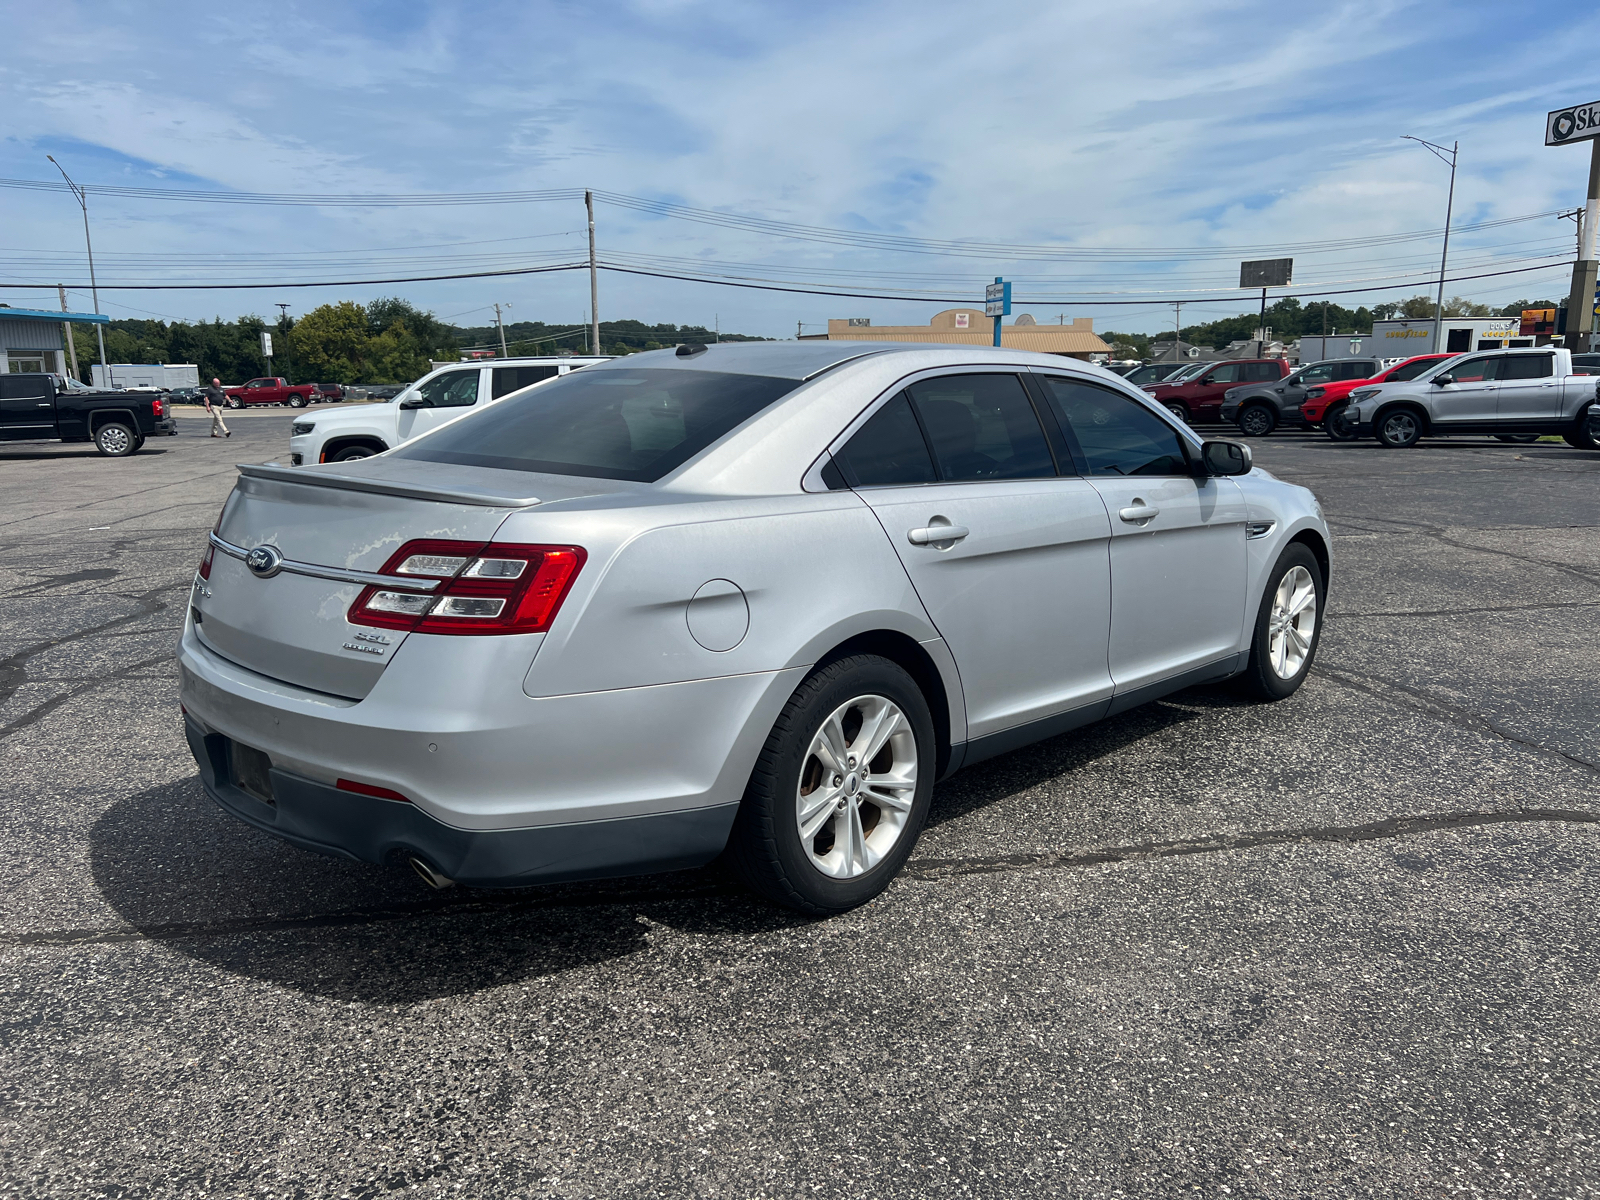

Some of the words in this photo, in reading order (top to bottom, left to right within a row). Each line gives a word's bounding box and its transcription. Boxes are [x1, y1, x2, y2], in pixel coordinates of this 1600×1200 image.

[1576, 106, 1600, 131] Sk
[1385, 329, 1428, 339] GOODYEAR
[1482, 330, 1520, 338] GOODYE
[247, 549, 269, 568] Ford
[353, 632, 390, 646] SEL
